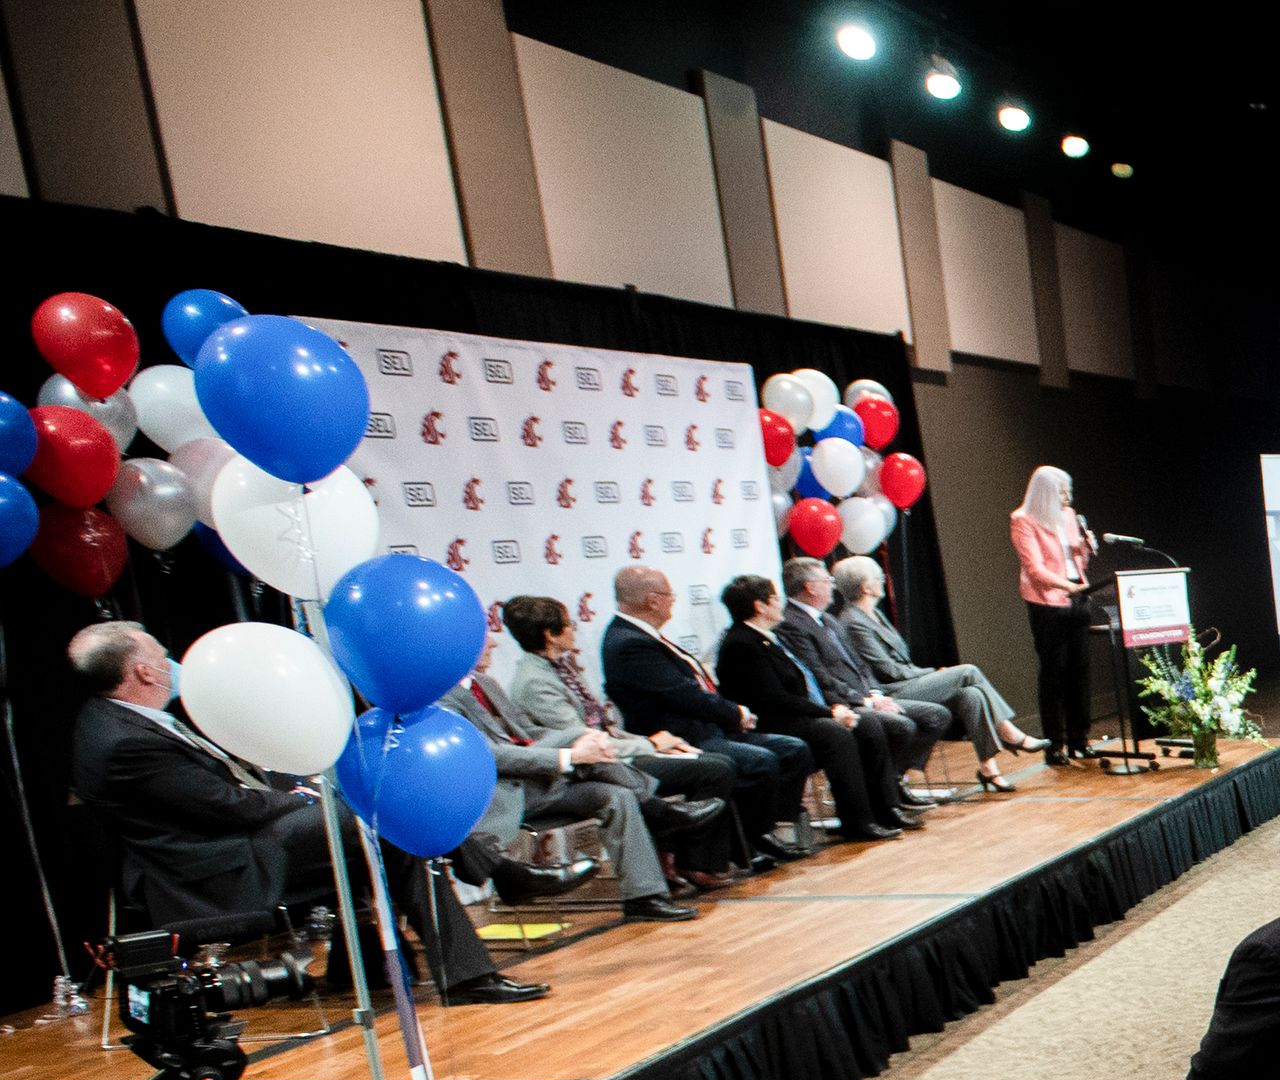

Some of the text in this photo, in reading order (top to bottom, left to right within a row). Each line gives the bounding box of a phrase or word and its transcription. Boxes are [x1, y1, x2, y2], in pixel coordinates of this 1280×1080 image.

[382, 353, 411, 373] SEL
[486, 362, 512, 381] SEL
[470, 420, 498, 438] SEL
[406, 486, 433, 502] SEL
[509, 485, 533, 501] SEL
[494, 544, 519, 560] SEL
